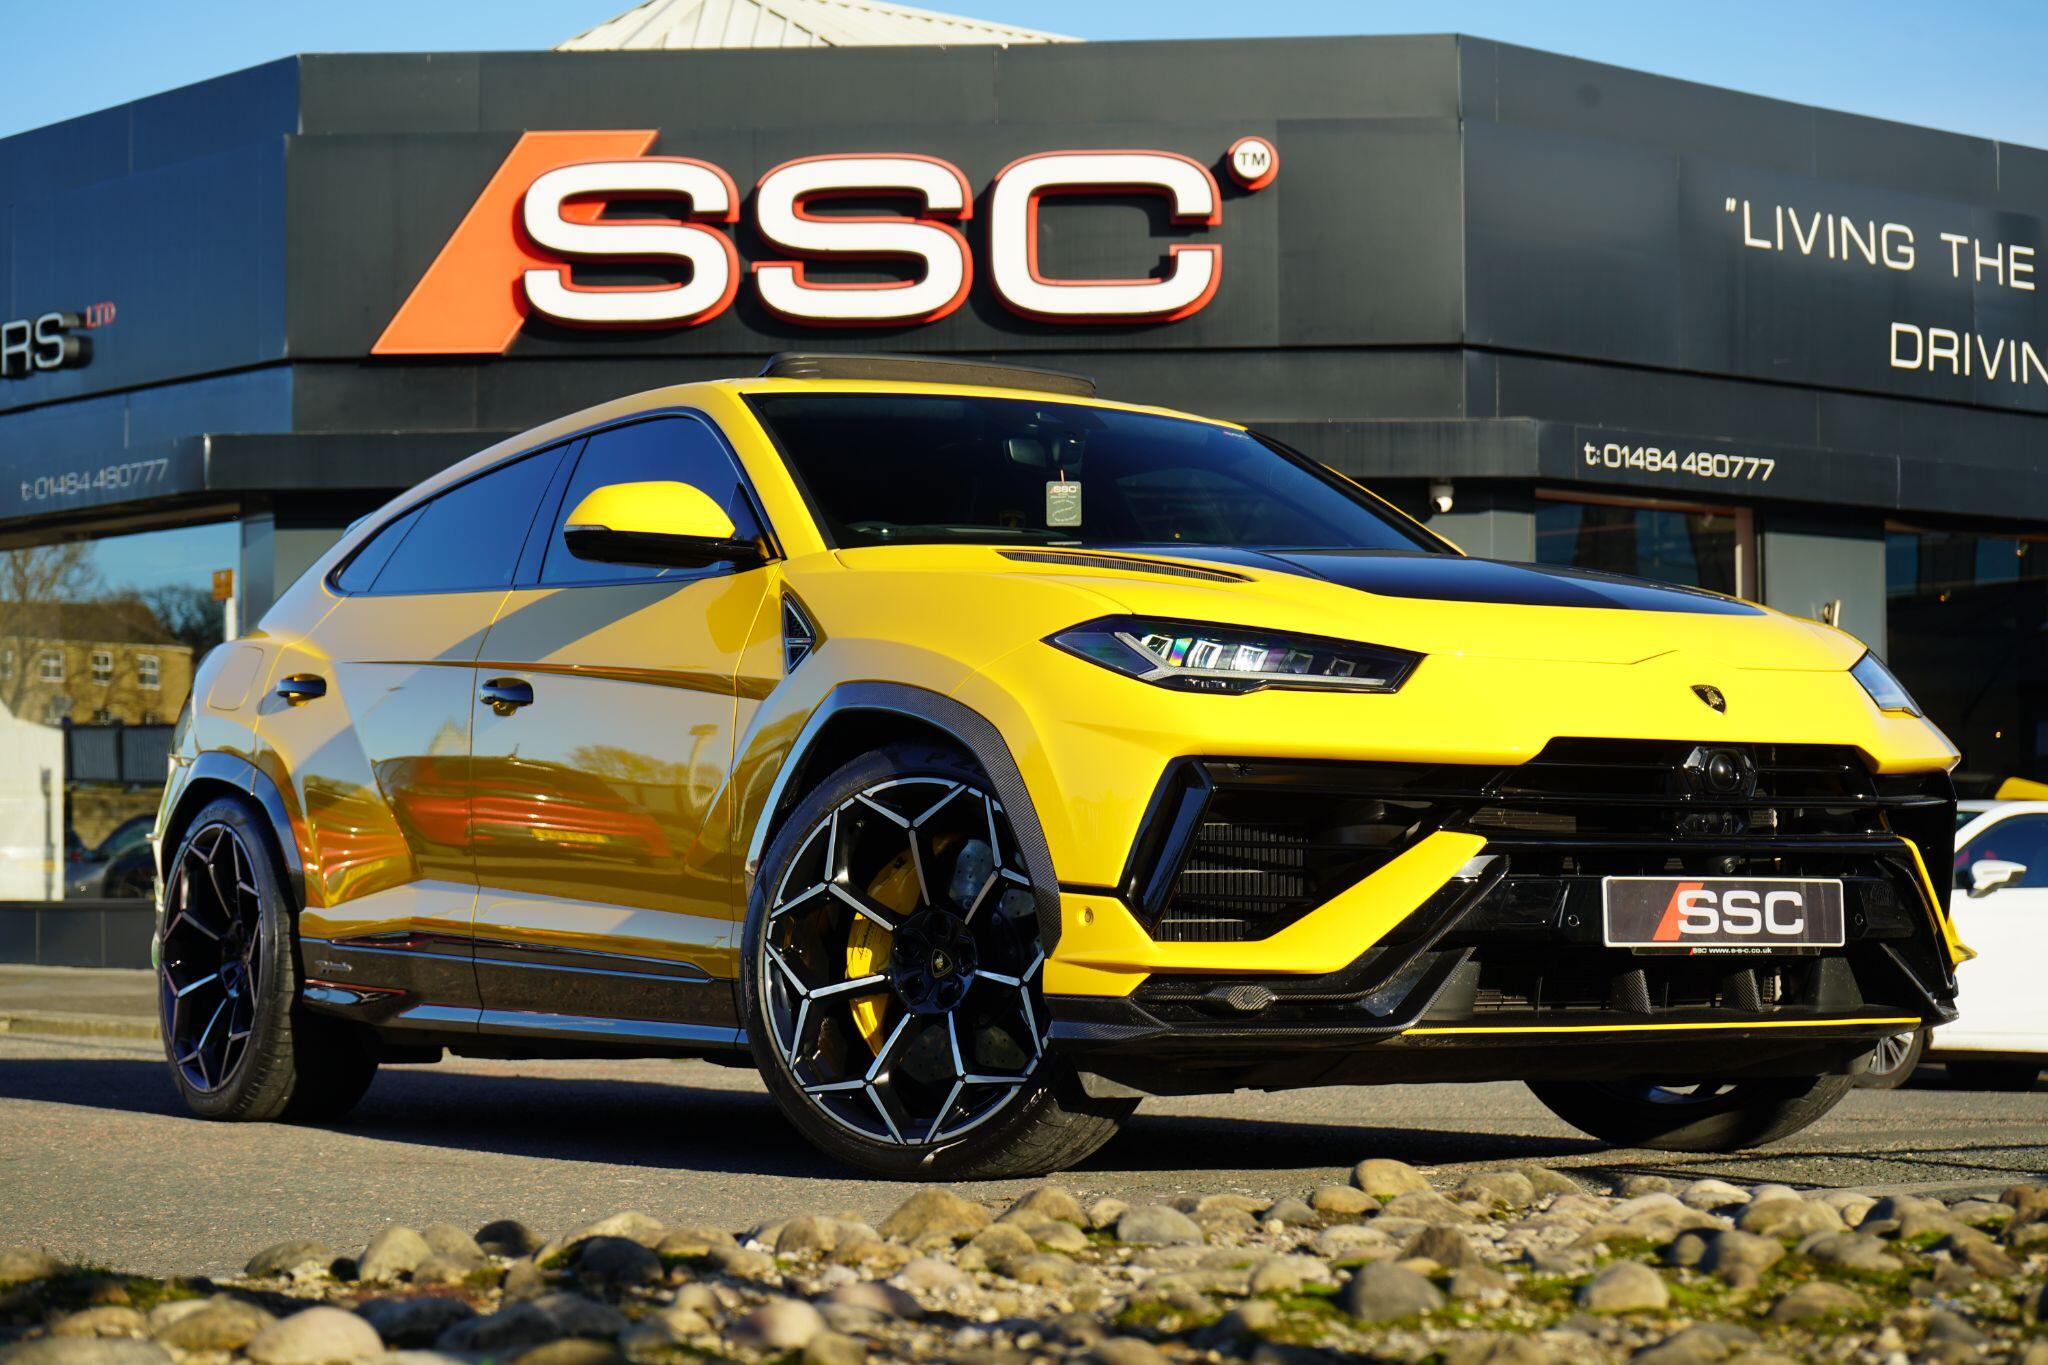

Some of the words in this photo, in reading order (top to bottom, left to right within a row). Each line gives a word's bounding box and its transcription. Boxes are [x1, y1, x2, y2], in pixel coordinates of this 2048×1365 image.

[1240, 152, 1266, 166] TM
[522, 150, 1222, 326] SSC
[1940, 232, 2036, 290] THE
[85, 301, 117, 329] LTD
[1891, 322, 2048, 386] DRIVIN
[1681, 452, 1776, 482] 480777
[1677, 890, 1804, 935] SSC
